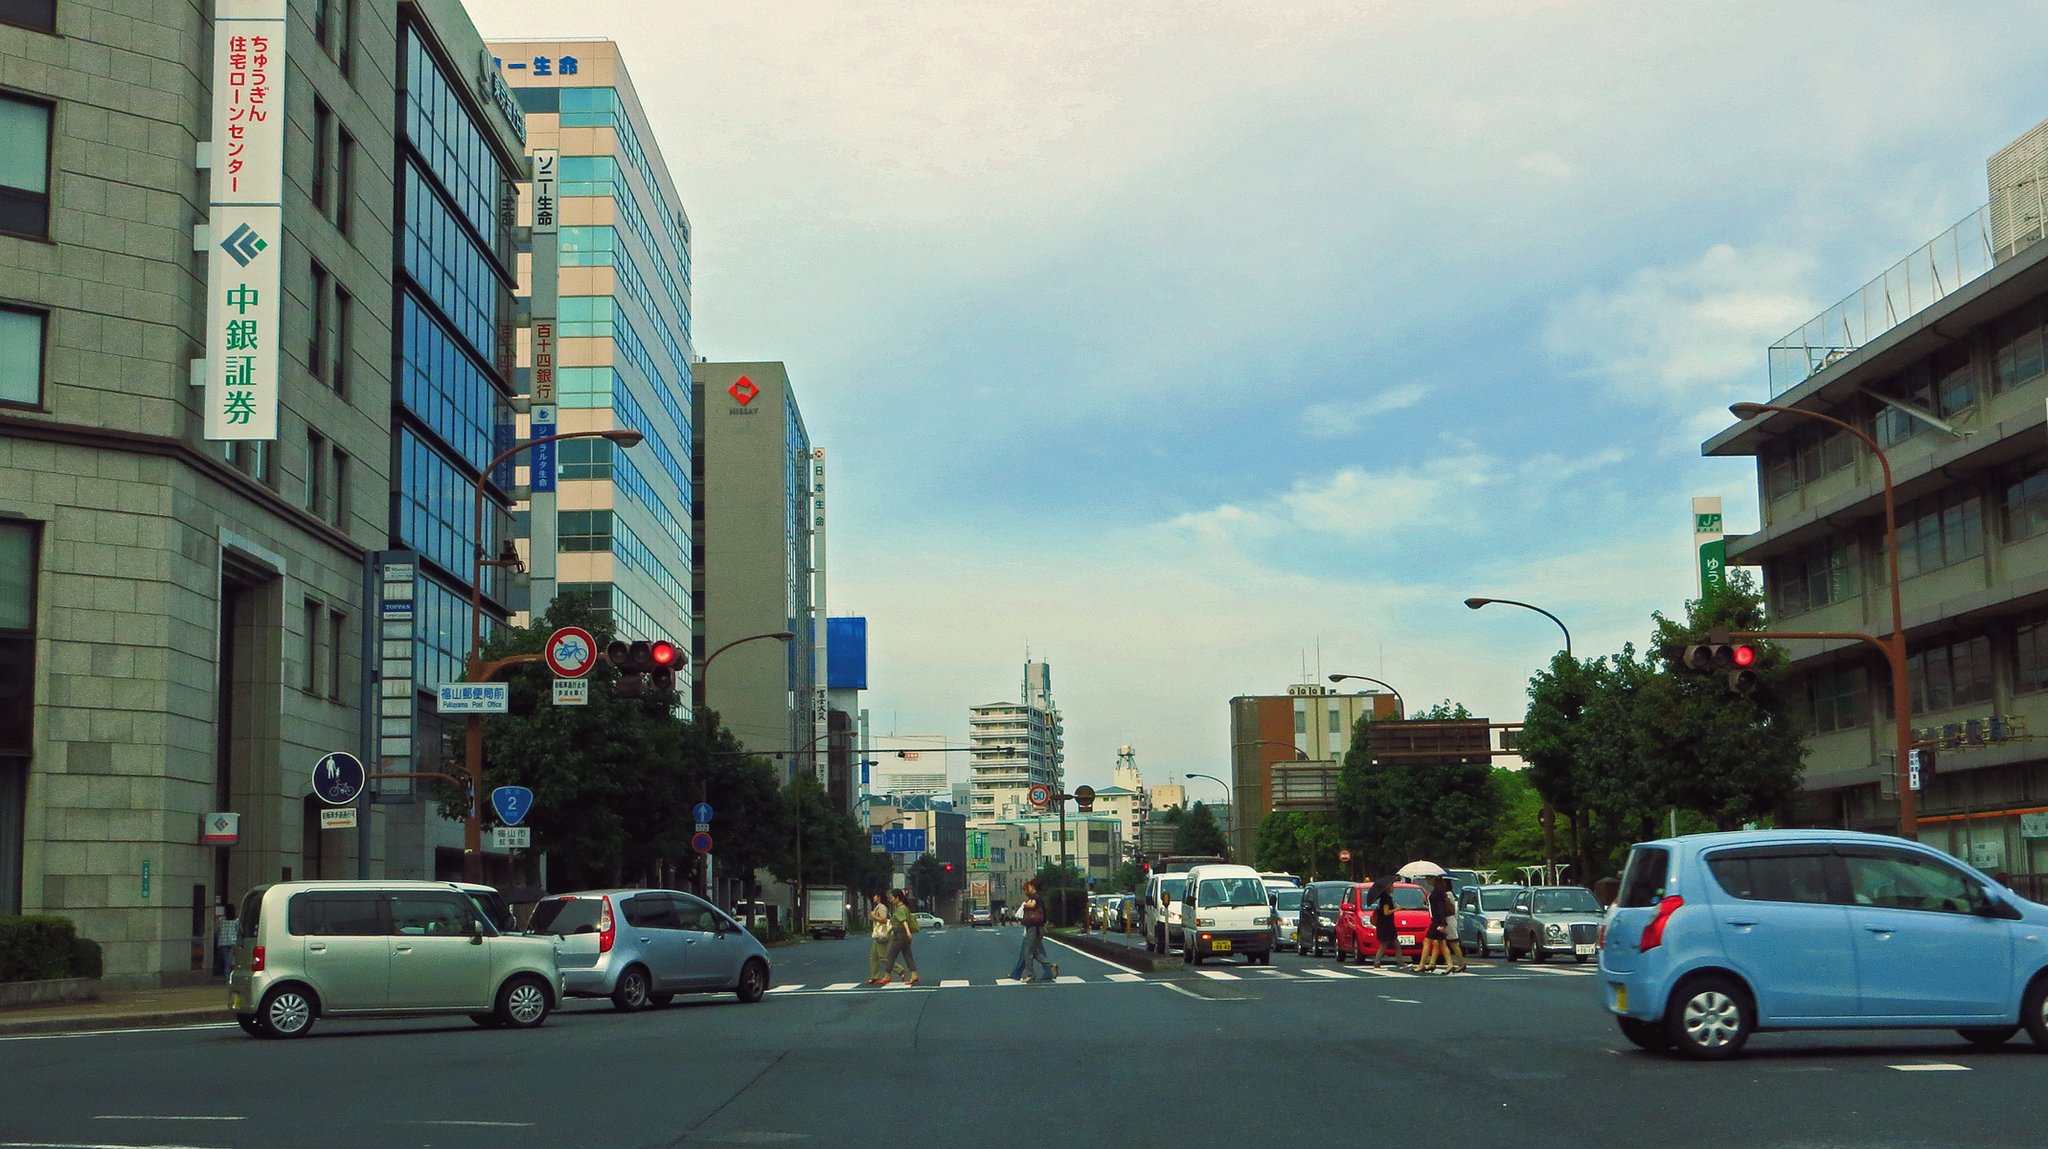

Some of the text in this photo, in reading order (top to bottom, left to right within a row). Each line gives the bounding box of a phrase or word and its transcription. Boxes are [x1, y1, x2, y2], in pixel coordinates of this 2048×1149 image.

[249, 36, 269, 122] ちゅうぎん
[494, 56, 578, 75] 一生命
[228, 36, 247, 192] 住宅ローンセンター
[537, 156, 553, 226] ソニー生命
[223, 283, 259, 424] 中銀証券
[537, 324, 551, 399] 百十四銀行
[815, 466, 824, 526] 日本生命
[441, 687, 504, 700] 福山郵便局前
[443, 701, 468, 709] Fukuyama
[508, 796, 517, 810] 2
[1033, 790, 1045, 801] 50
[498, 829, 526, 838] 福山市
